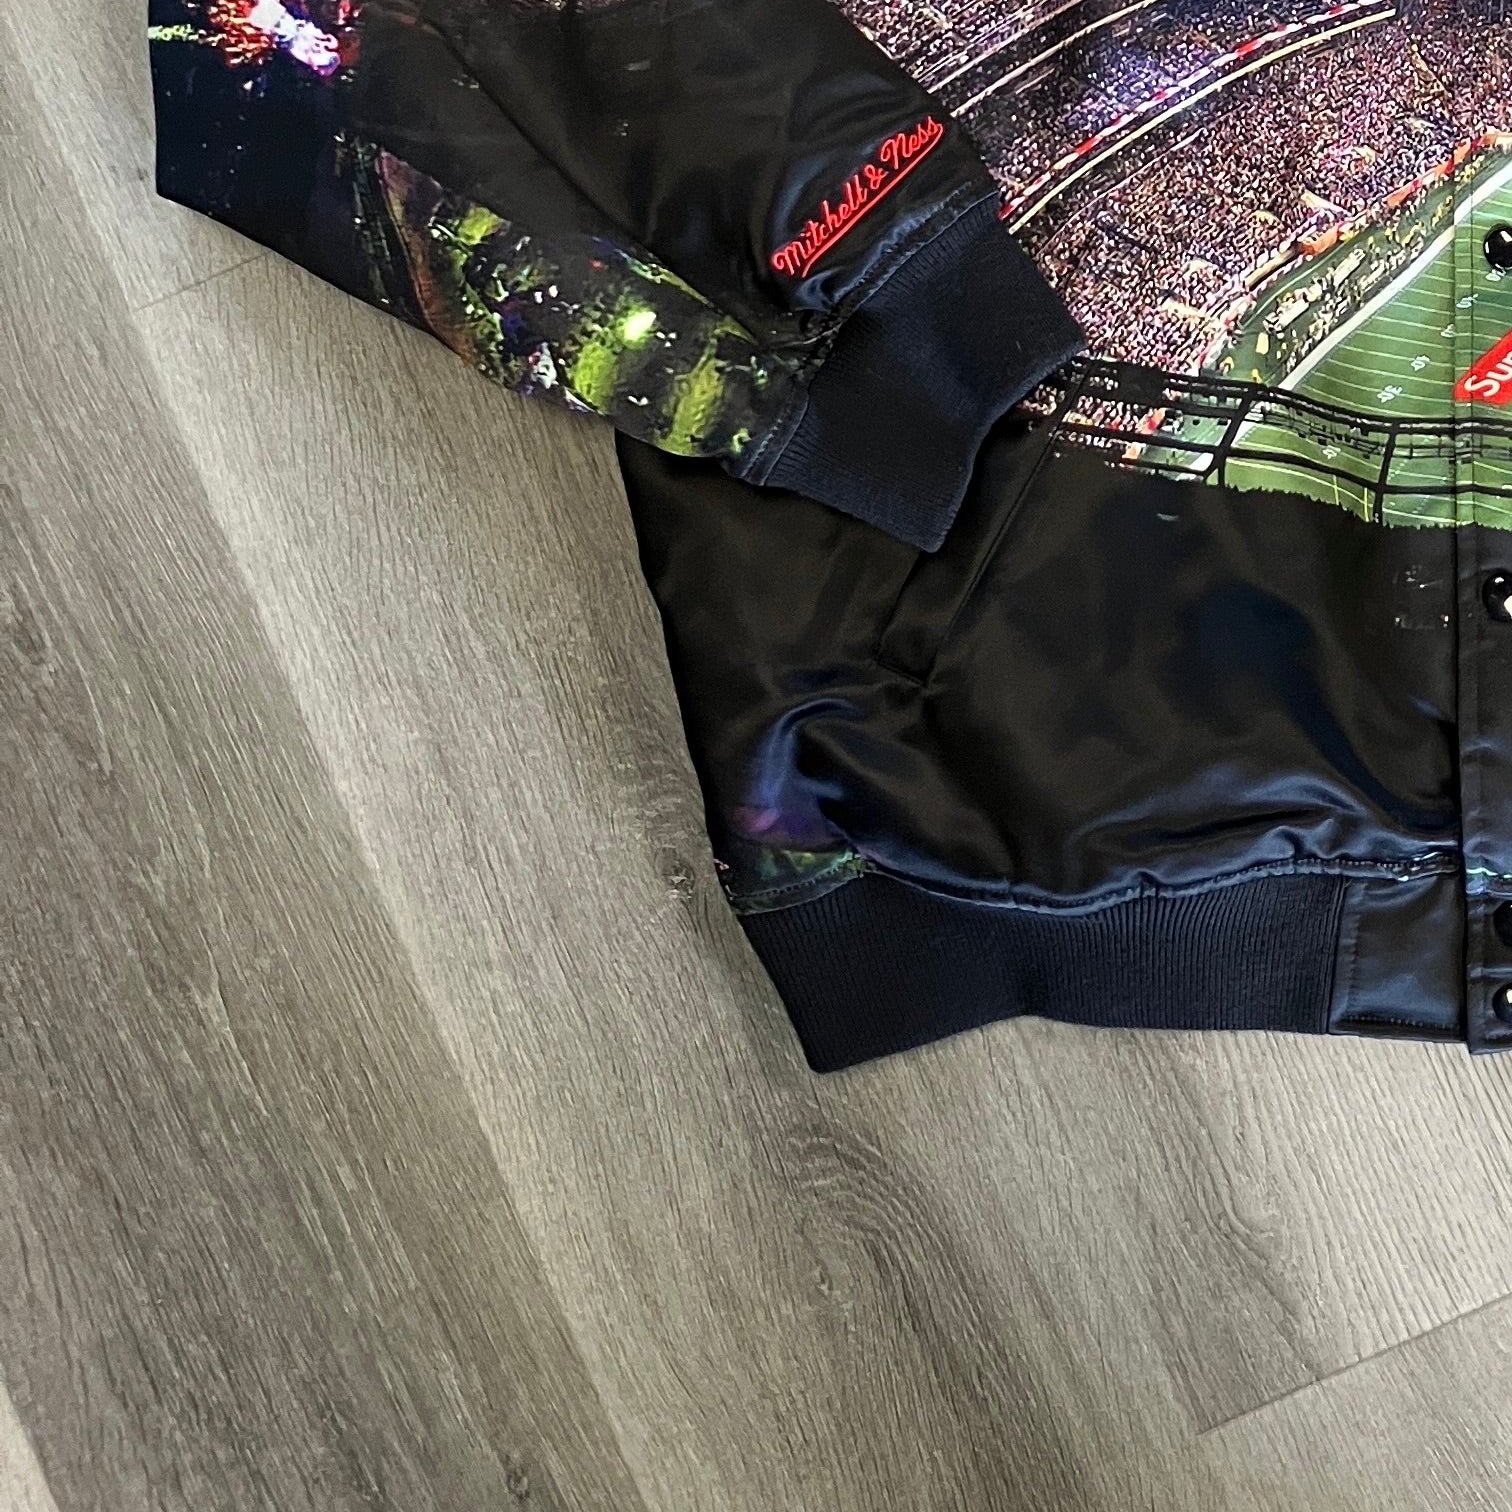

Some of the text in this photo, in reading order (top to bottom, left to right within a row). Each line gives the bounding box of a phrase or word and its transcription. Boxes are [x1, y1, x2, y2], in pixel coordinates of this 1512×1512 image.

[770, 115, 940, 276] Mitchell & Ness
